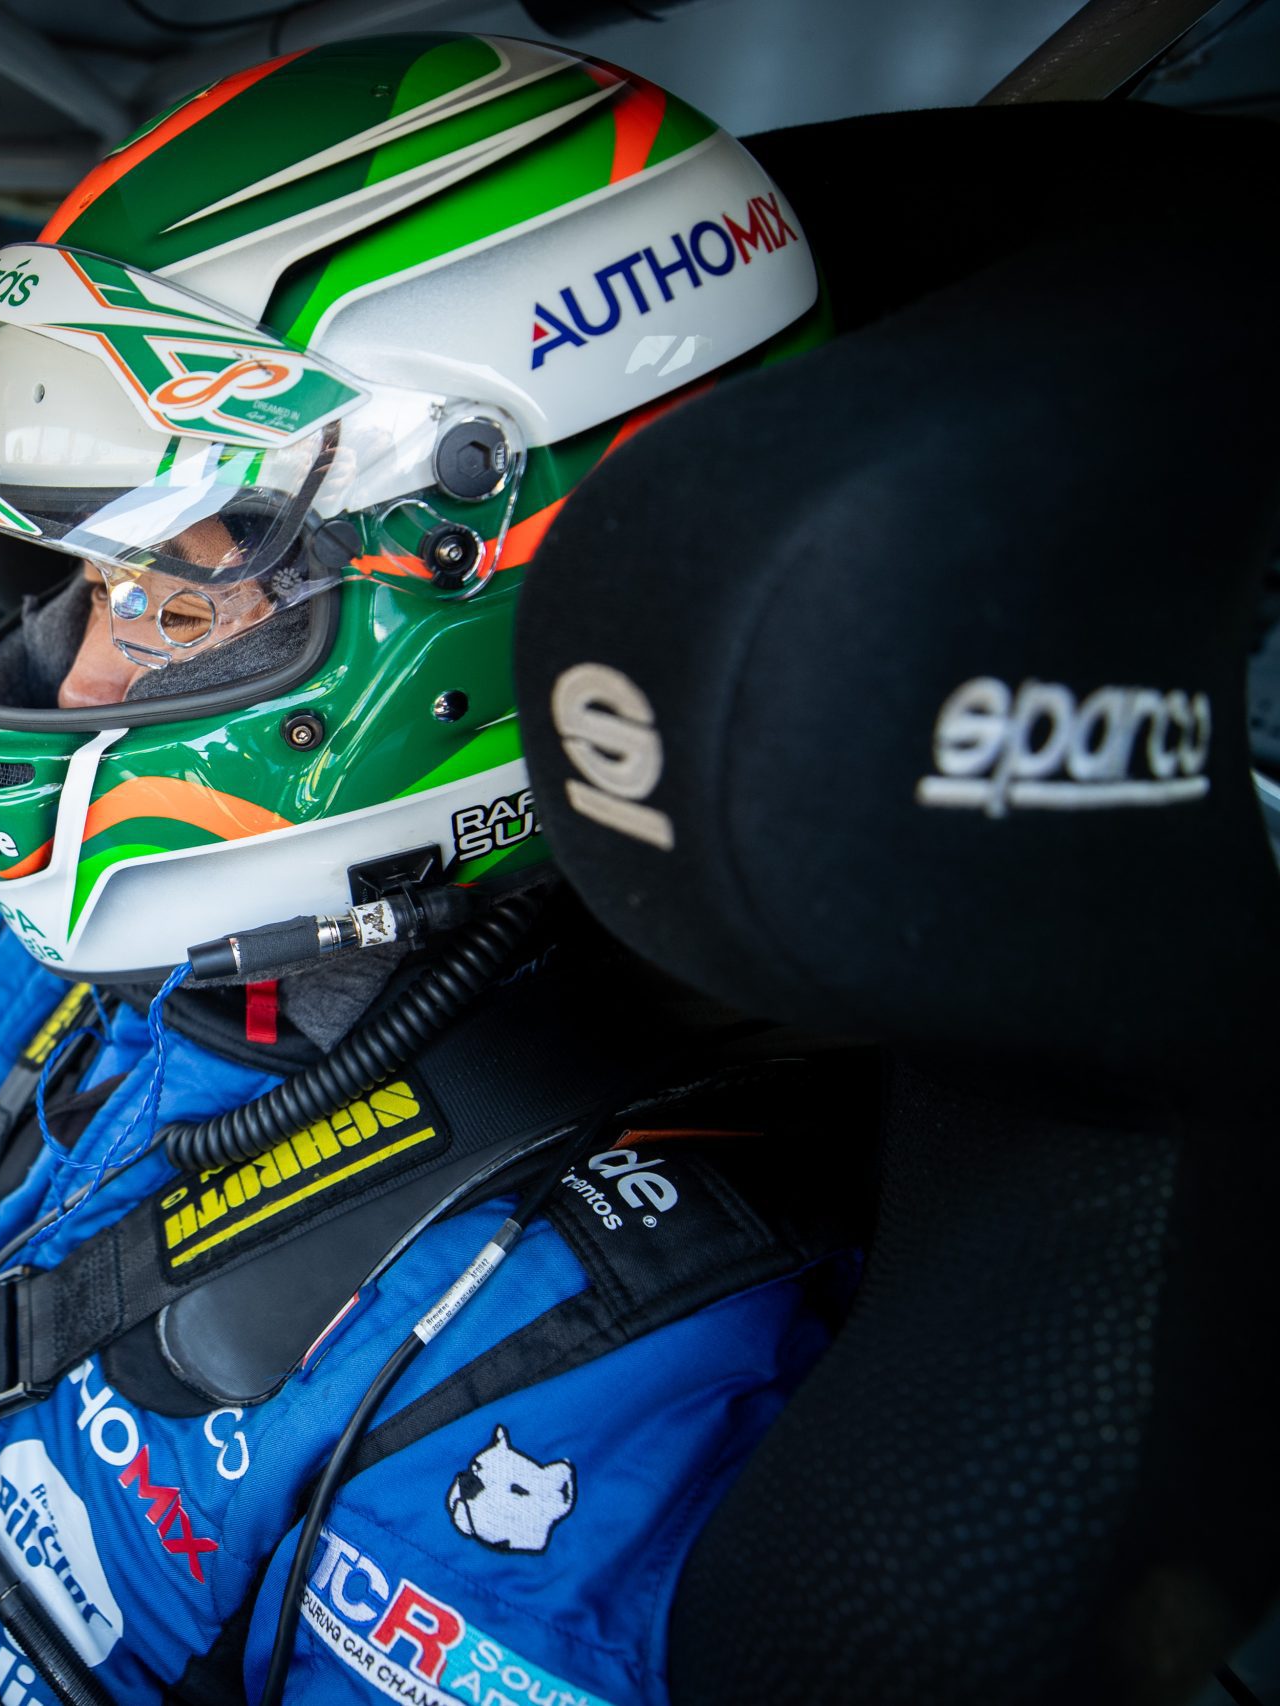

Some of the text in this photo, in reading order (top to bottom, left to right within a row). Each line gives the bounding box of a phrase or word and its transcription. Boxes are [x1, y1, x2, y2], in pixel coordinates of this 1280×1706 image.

[532, 192, 798, 370] AUTHOMIX
[459, 812, 543, 861] SU
[302, 1592, 341, 1641] OURING
[343, 1636, 375, 1671] CAR
[309, 1526, 466, 1686] TCR
